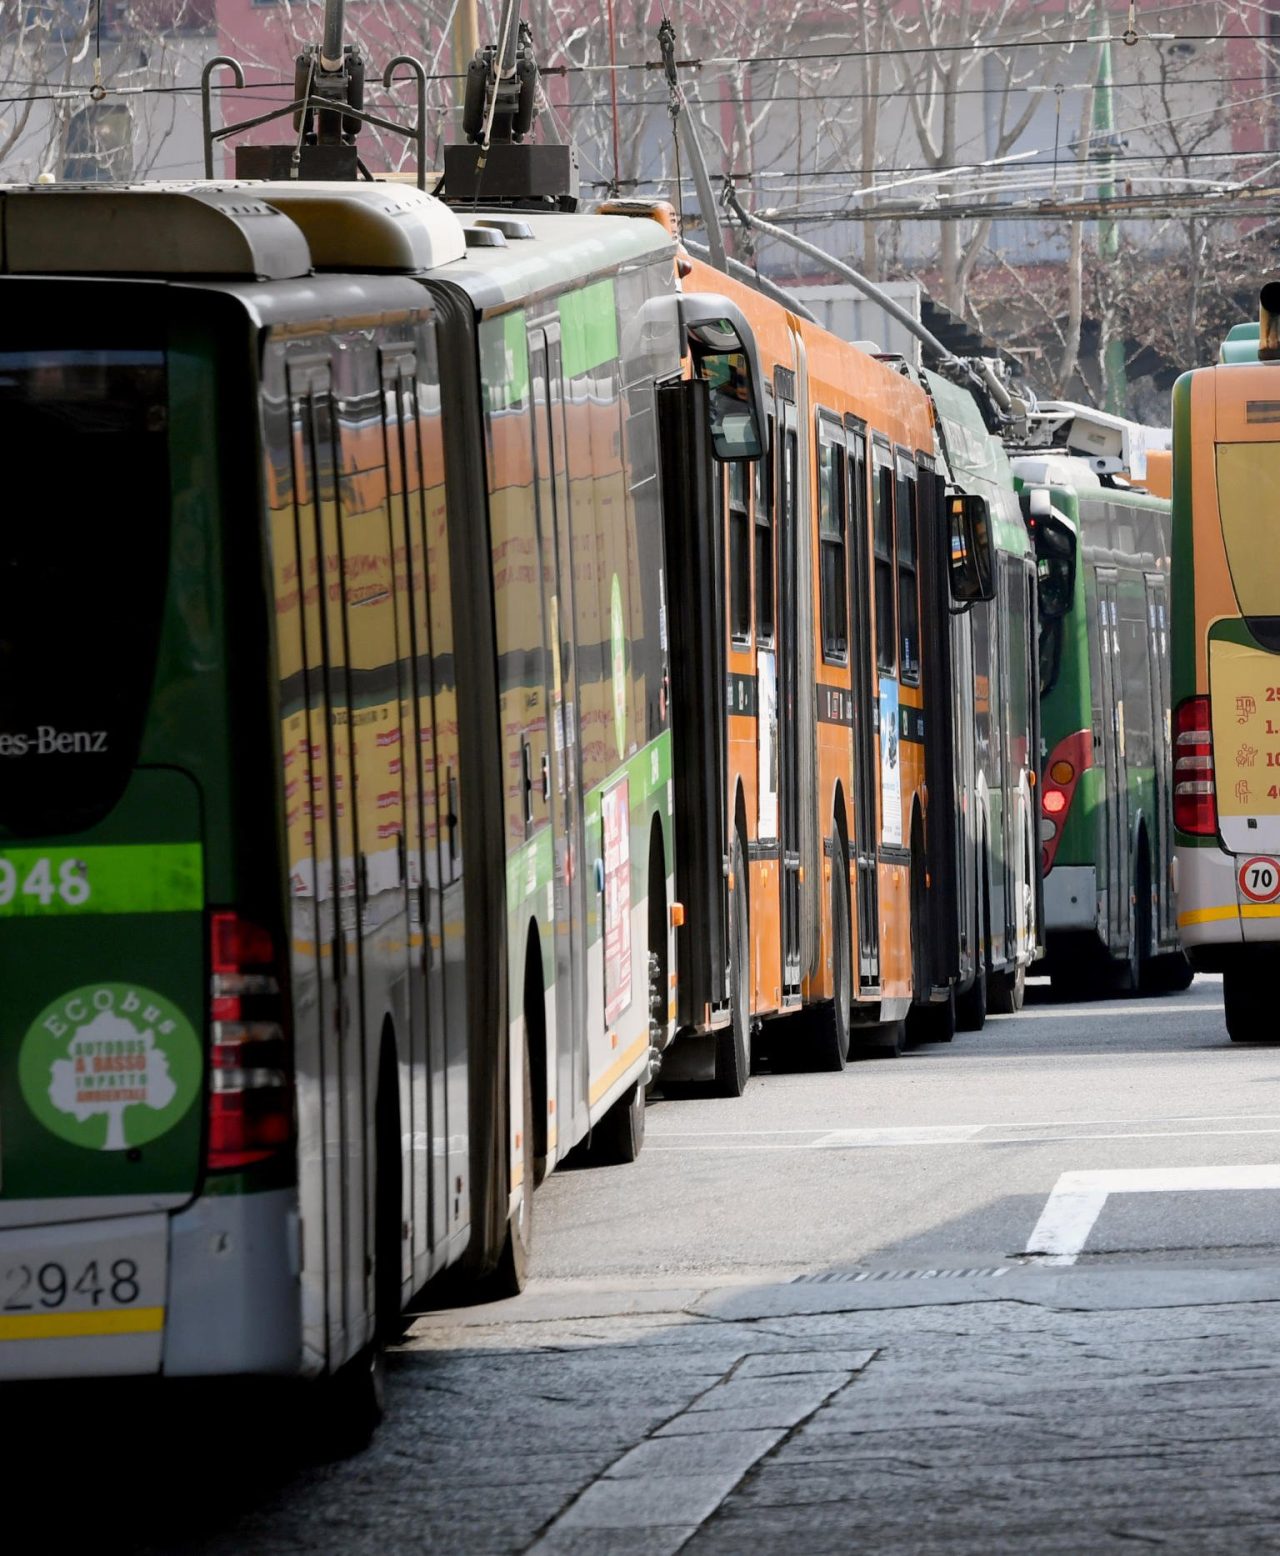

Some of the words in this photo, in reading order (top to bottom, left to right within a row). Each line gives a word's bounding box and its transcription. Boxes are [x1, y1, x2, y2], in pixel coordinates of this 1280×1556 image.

[1251, 869, 1273, 889] 70
[75, 1056, 86, 1073] A
[93, 1055, 147, 1073] BASSO
[75, 1073, 148, 1088] IMPATTO
